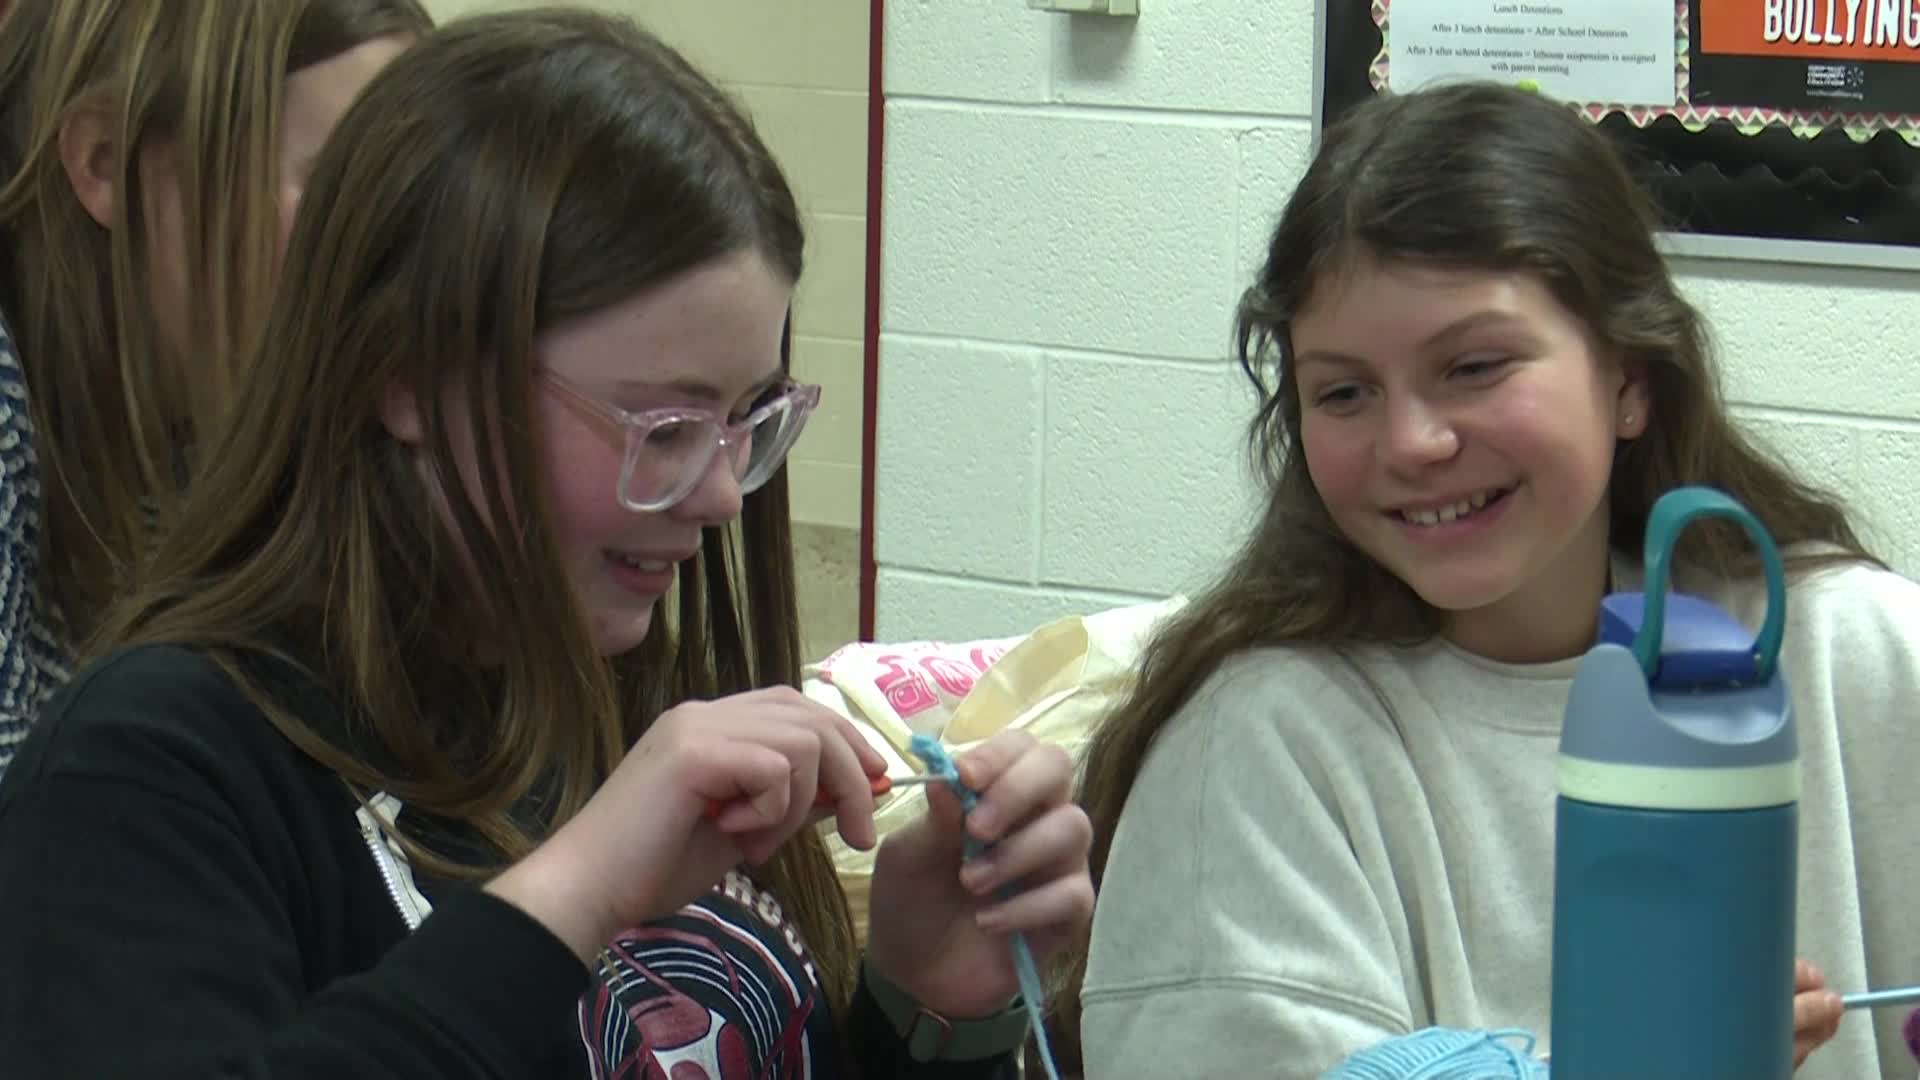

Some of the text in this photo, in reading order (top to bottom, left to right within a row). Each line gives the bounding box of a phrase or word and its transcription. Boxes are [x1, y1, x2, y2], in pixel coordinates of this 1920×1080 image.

[1493, 5, 1563, 16] Lunch Detentions
[1431, 23, 1452, 33] After
[1454, 24, 1459, 33] 3
[1461, 24, 1483, 34] lunch
[1484, 25, 1525, 35] detentions
[1535, 26, 1556, 36] After
[1558, 26, 1586, 37] School
[1763, 0, 1920, 48] BULLYING
[1406, 46, 1426, 56] After
[1427, 46, 1433, 56] 3
[1435, 47, 1453, 56] after
[1454, 47, 1481, 57] school
[1482, 48, 1523, 58] detentions
[1566, 52, 1610, 63] suspension
[1612, 53, 1619, 61] is
[1621, 53, 1656, 64] assigned
[1490, 62, 1569, 76] with parent meeting
